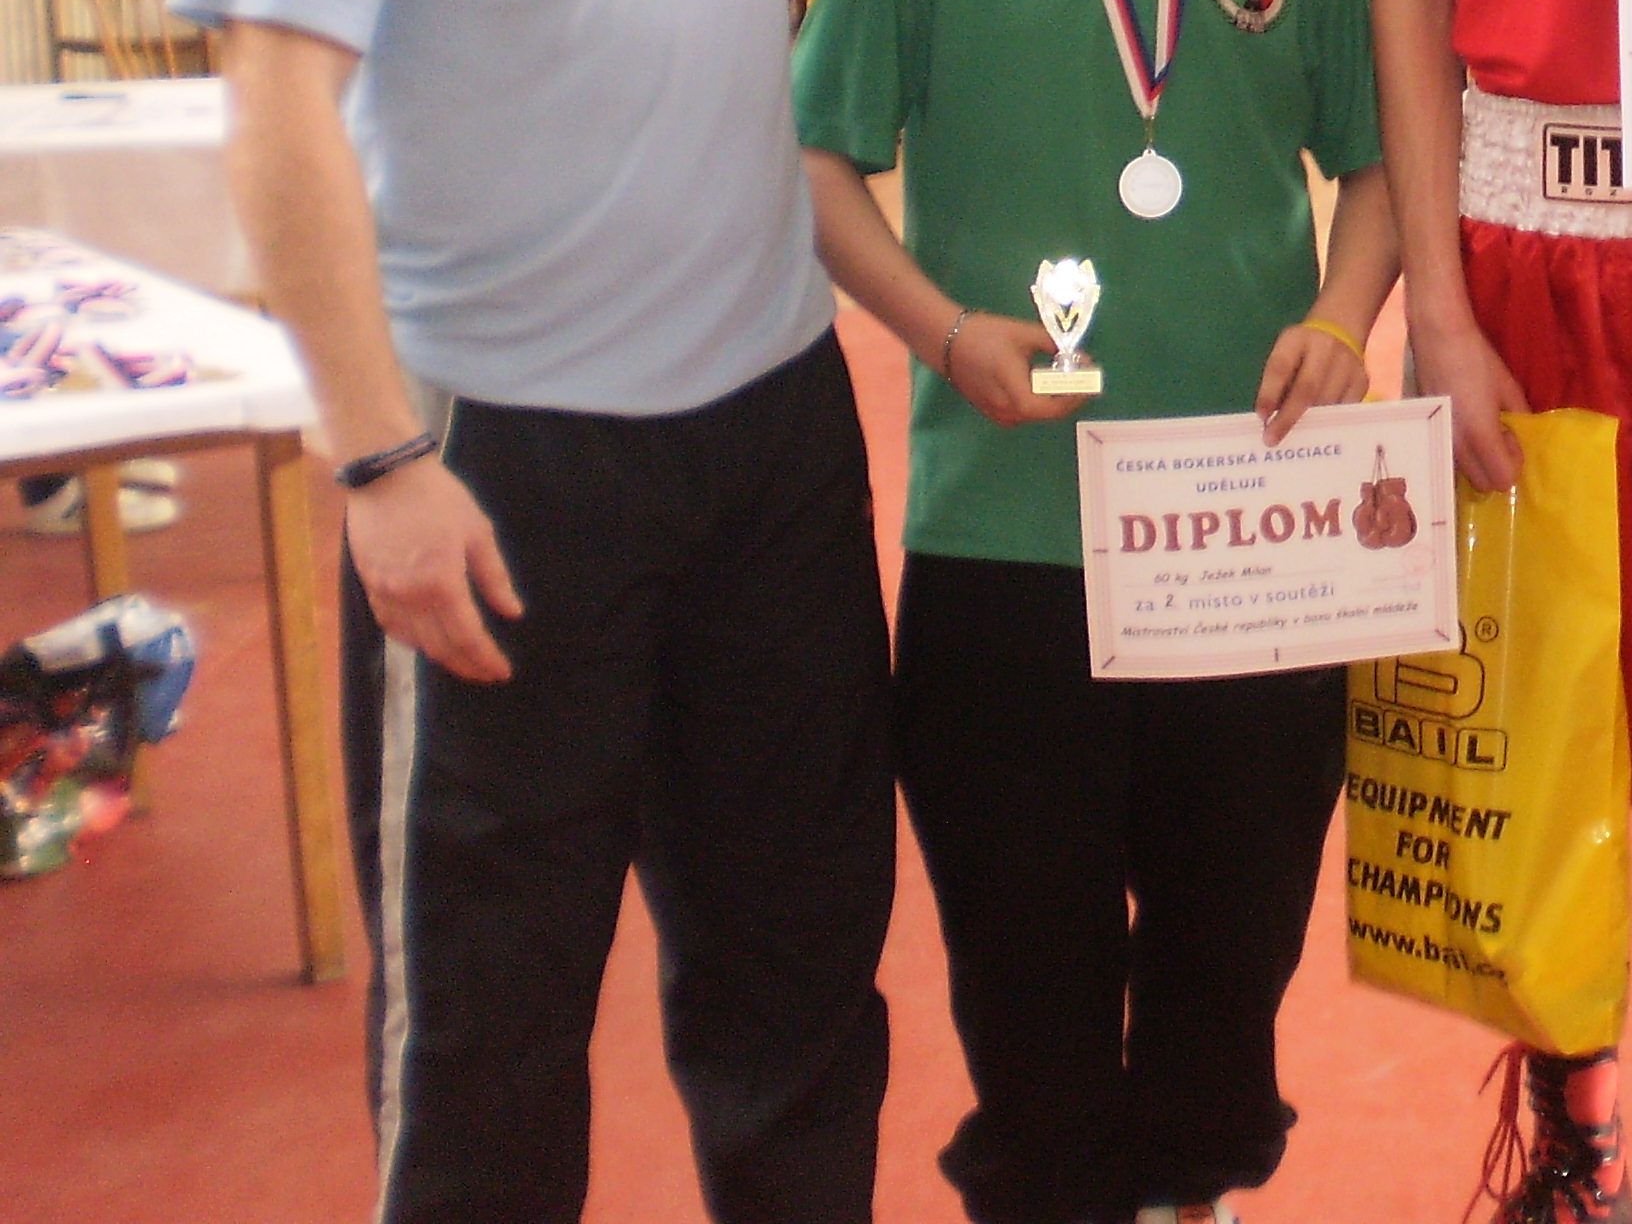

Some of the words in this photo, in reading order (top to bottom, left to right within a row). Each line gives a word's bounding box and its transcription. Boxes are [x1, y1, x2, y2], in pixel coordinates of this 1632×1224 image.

[1551, 134, 1623, 187] TIT
[1116, 457, 1167, 472] ČESKÁ
[1171, 451, 1258, 470] BOXERSKÁ
[1263, 444, 1343, 463] ASOCIACE
[1196, 476, 1266, 494] UDĚLUJE
[1119, 497, 1343, 554] DIPLOM
[1135, 598, 1156, 612] za
[1188, 592, 1243, 611] místo
[1250, 594, 1259, 605] v
[1354, 707, 1496, 766] BAIL
[1348, 771, 1511, 841] EQUIPMENT
[1396, 830, 1450, 870] FOR
